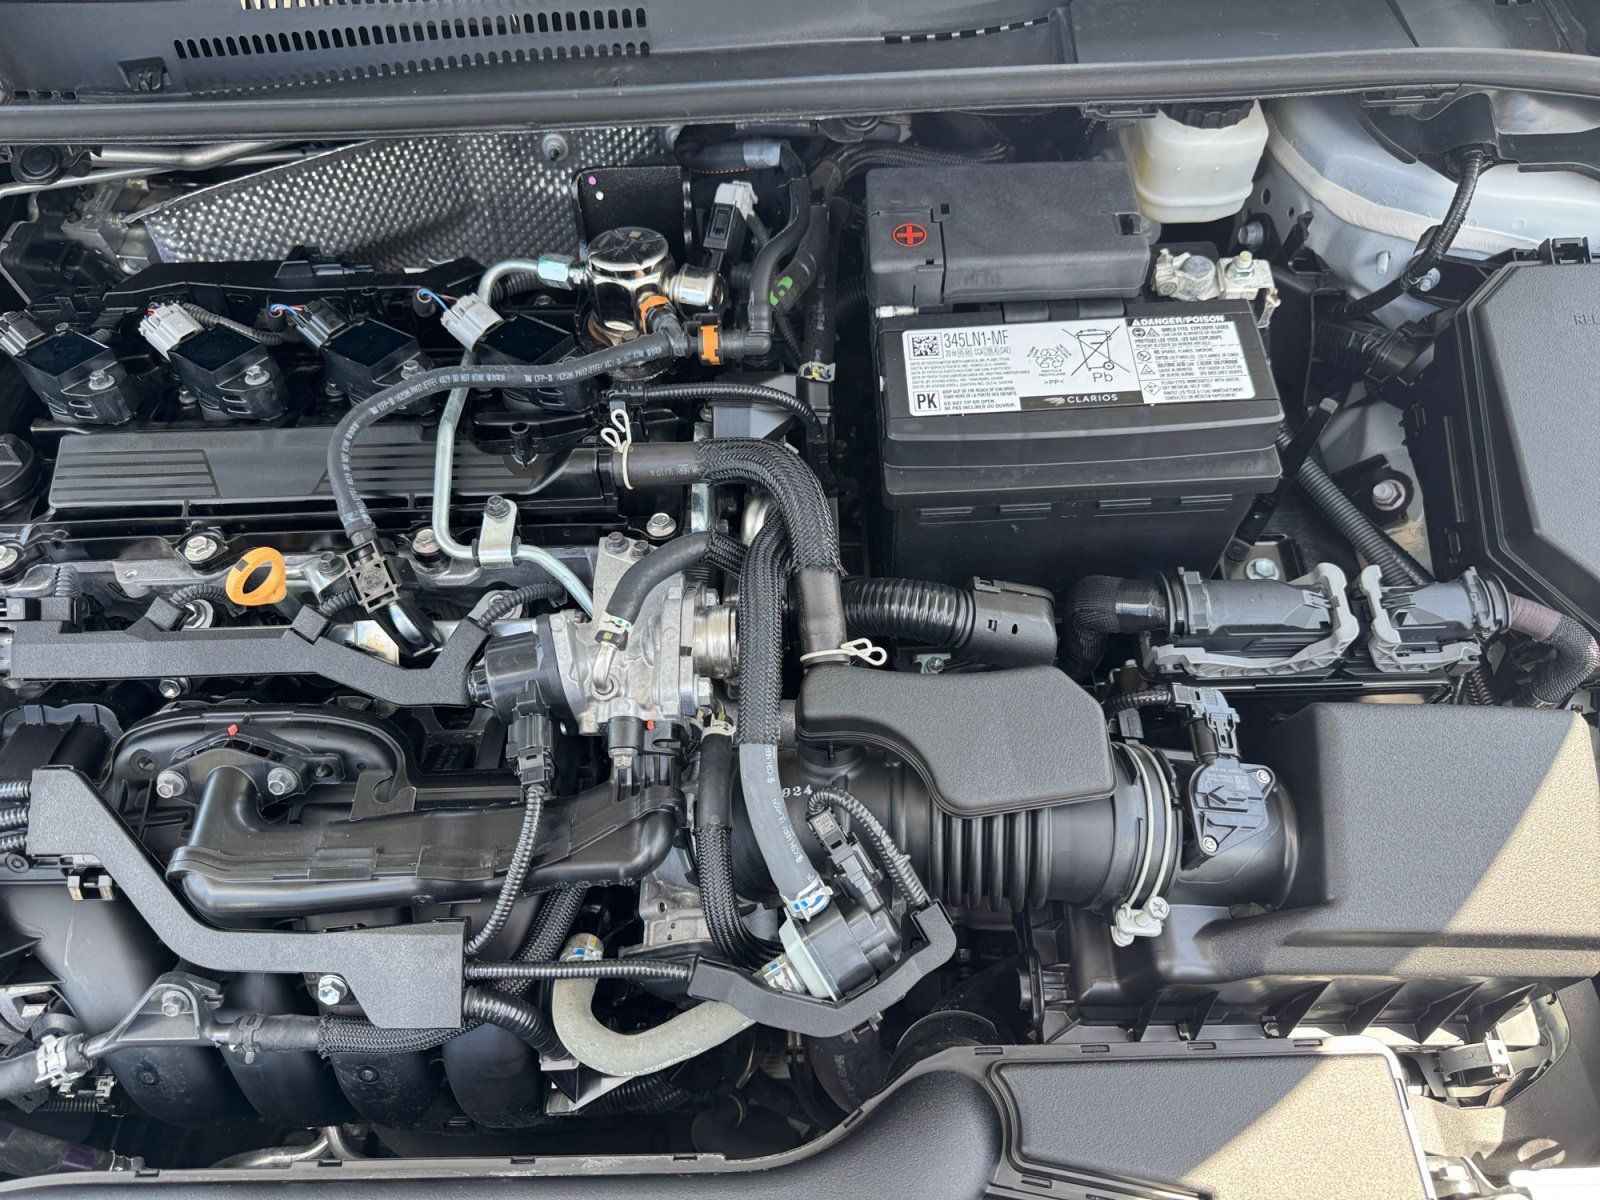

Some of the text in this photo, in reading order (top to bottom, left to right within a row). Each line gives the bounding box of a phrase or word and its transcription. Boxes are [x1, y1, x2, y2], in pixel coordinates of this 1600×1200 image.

[1139, 315, 1226, 327] DANGER/POISON
[943, 330, 1008, 348] 345LN1-MF
[1092, 372, 1113, 383] Pb
[916, 393, 938, 410] PK
[1066, 393, 1119, 404] CLARIOS
